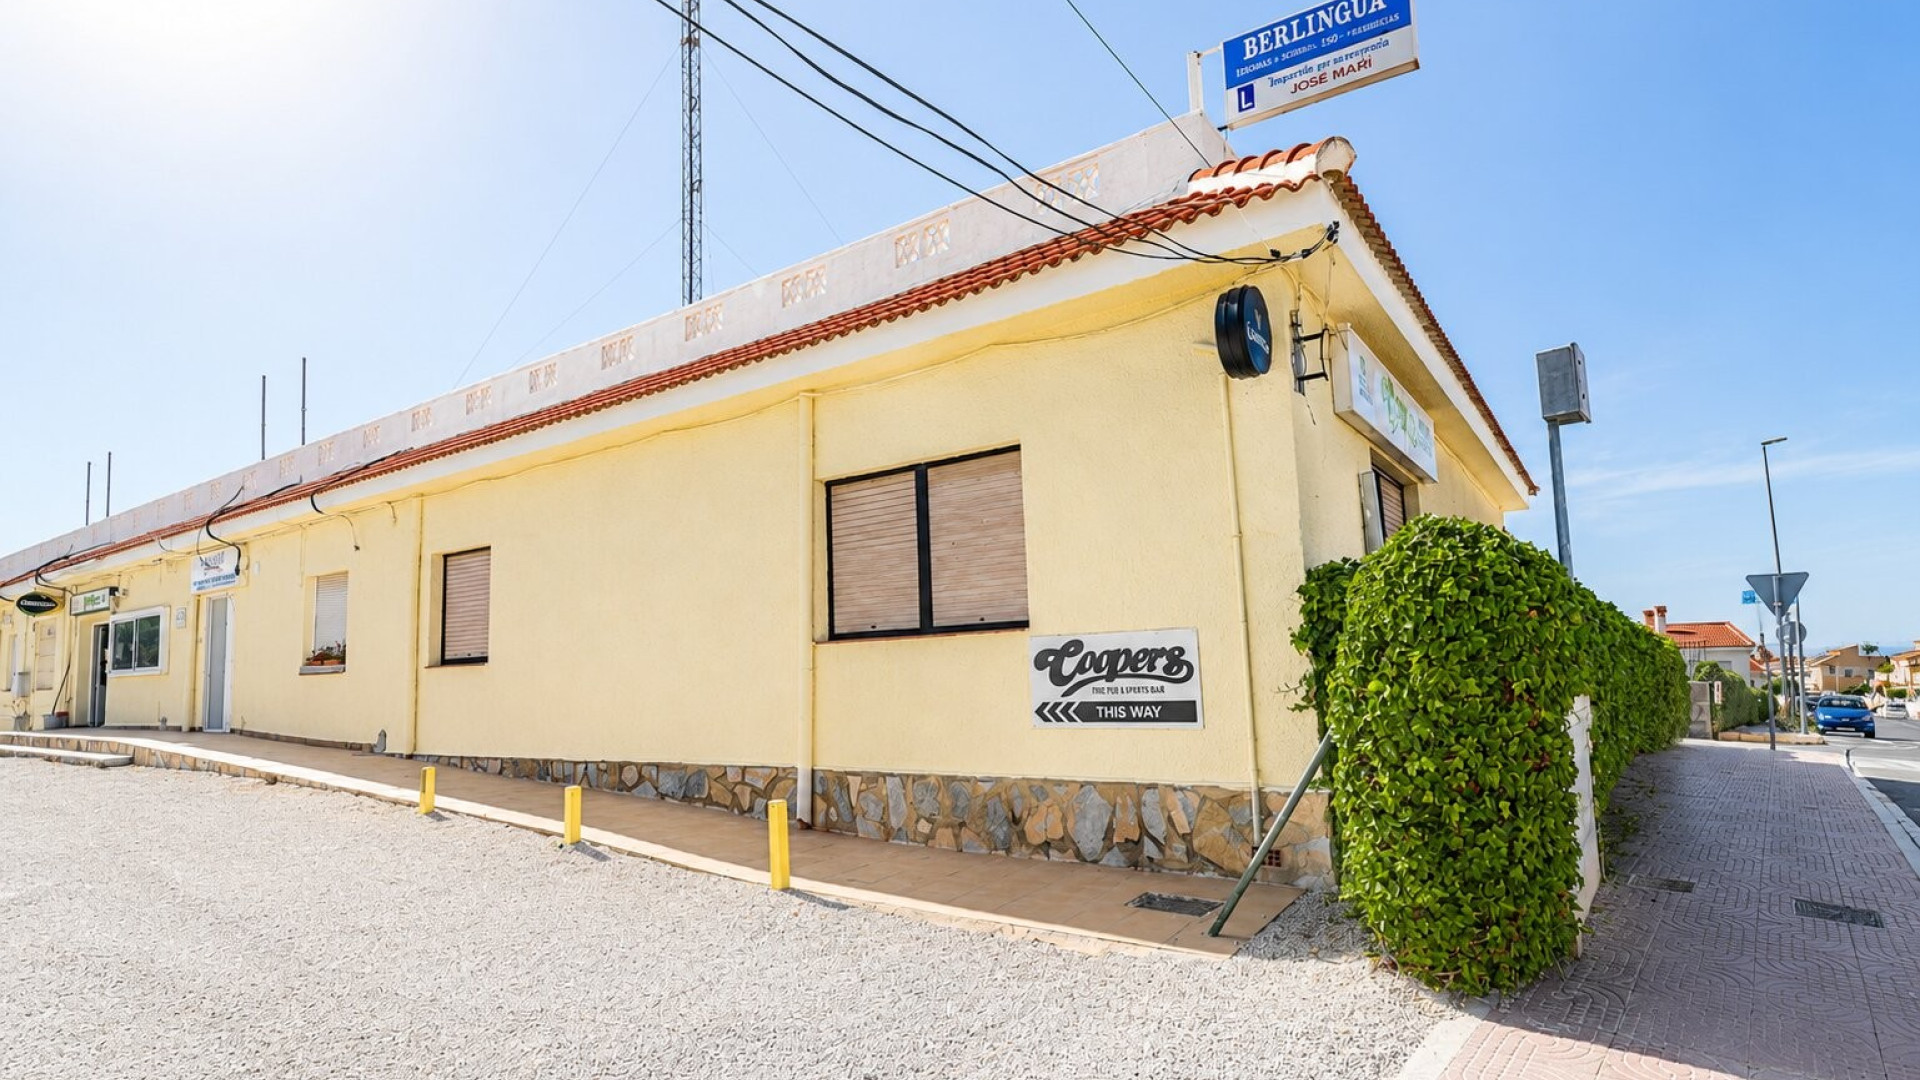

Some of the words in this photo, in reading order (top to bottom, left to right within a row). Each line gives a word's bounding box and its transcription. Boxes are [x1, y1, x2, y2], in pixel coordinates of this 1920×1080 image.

[1241, 90, 1253, 109] L
[1034, 639, 1194, 689] Coopers
[1096, 705, 1126, 718] THIS
[1129, 705, 1162, 718] WAY
